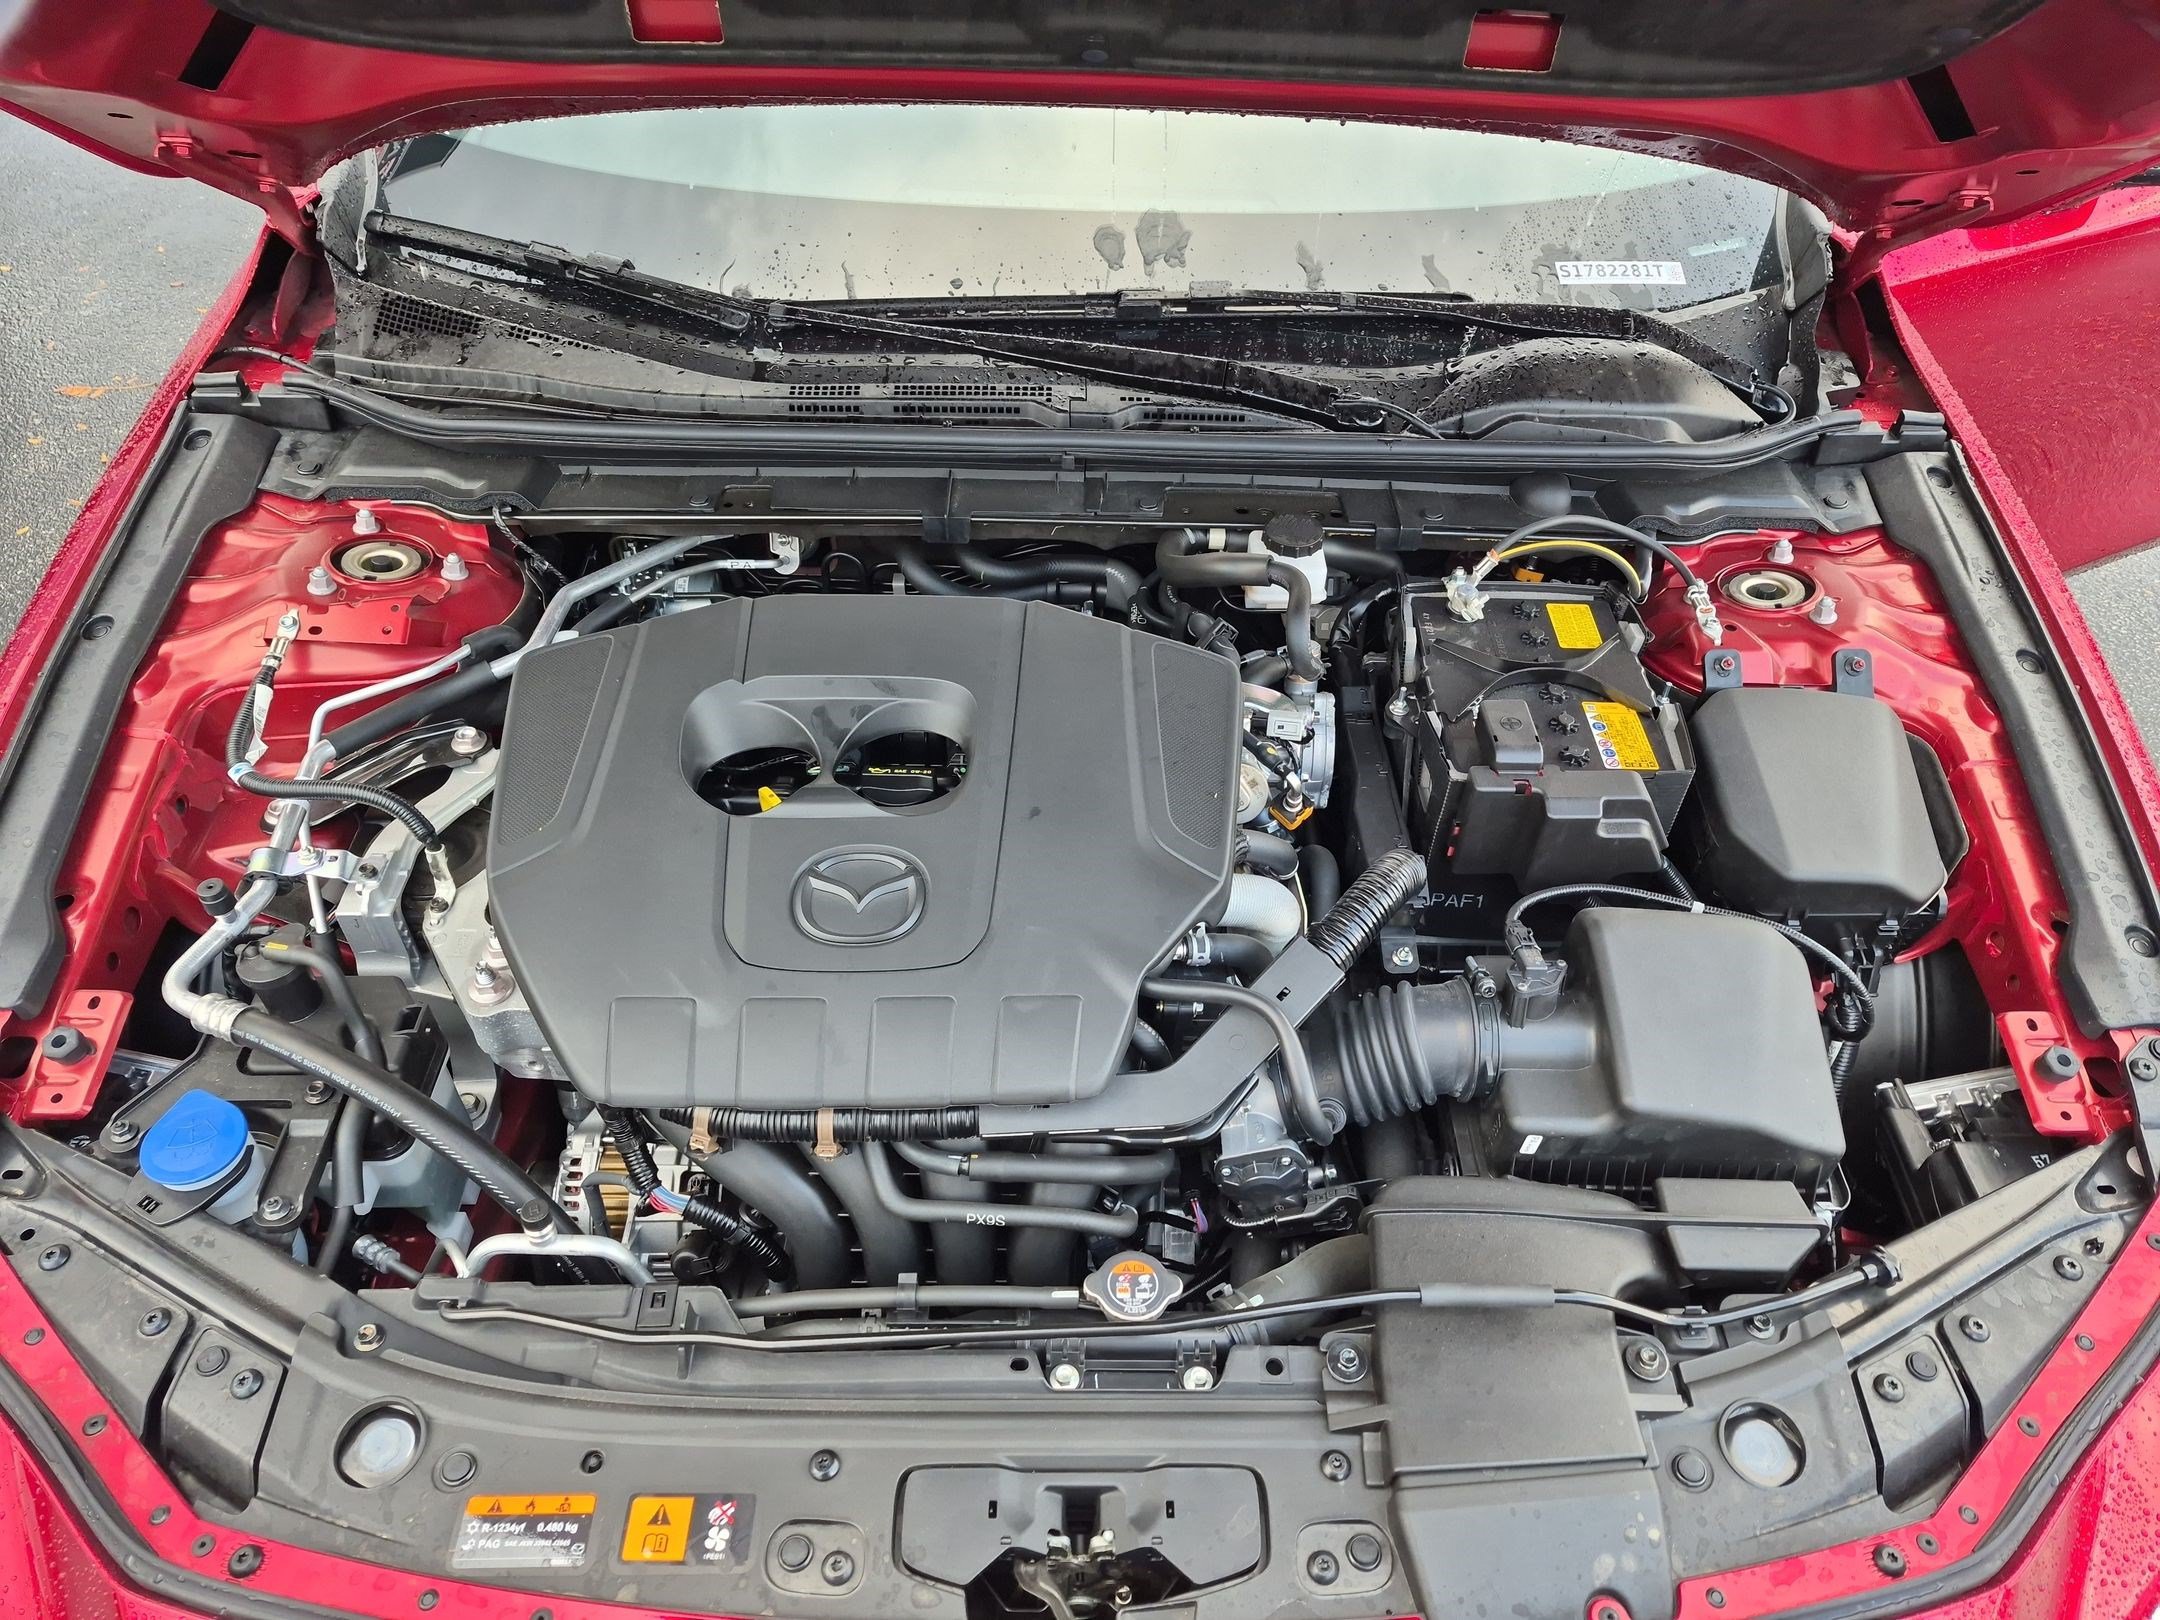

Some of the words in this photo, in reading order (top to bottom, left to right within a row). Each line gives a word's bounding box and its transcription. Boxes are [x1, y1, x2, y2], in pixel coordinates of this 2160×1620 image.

[1559, 264, 1664, 279] S1782281T
[1430, 892, 1485, 909] PAF1
[303, 1058, 331, 1077] SUCTION
[331, 1072, 350, 1087] HOSE
[966, 1213, 1006, 1227] PX9S
[481, 1522, 527, 1535] R-1234yf
[564, 1521, 579, 1534] kg
[477, 1539, 501, 1549] PAG
